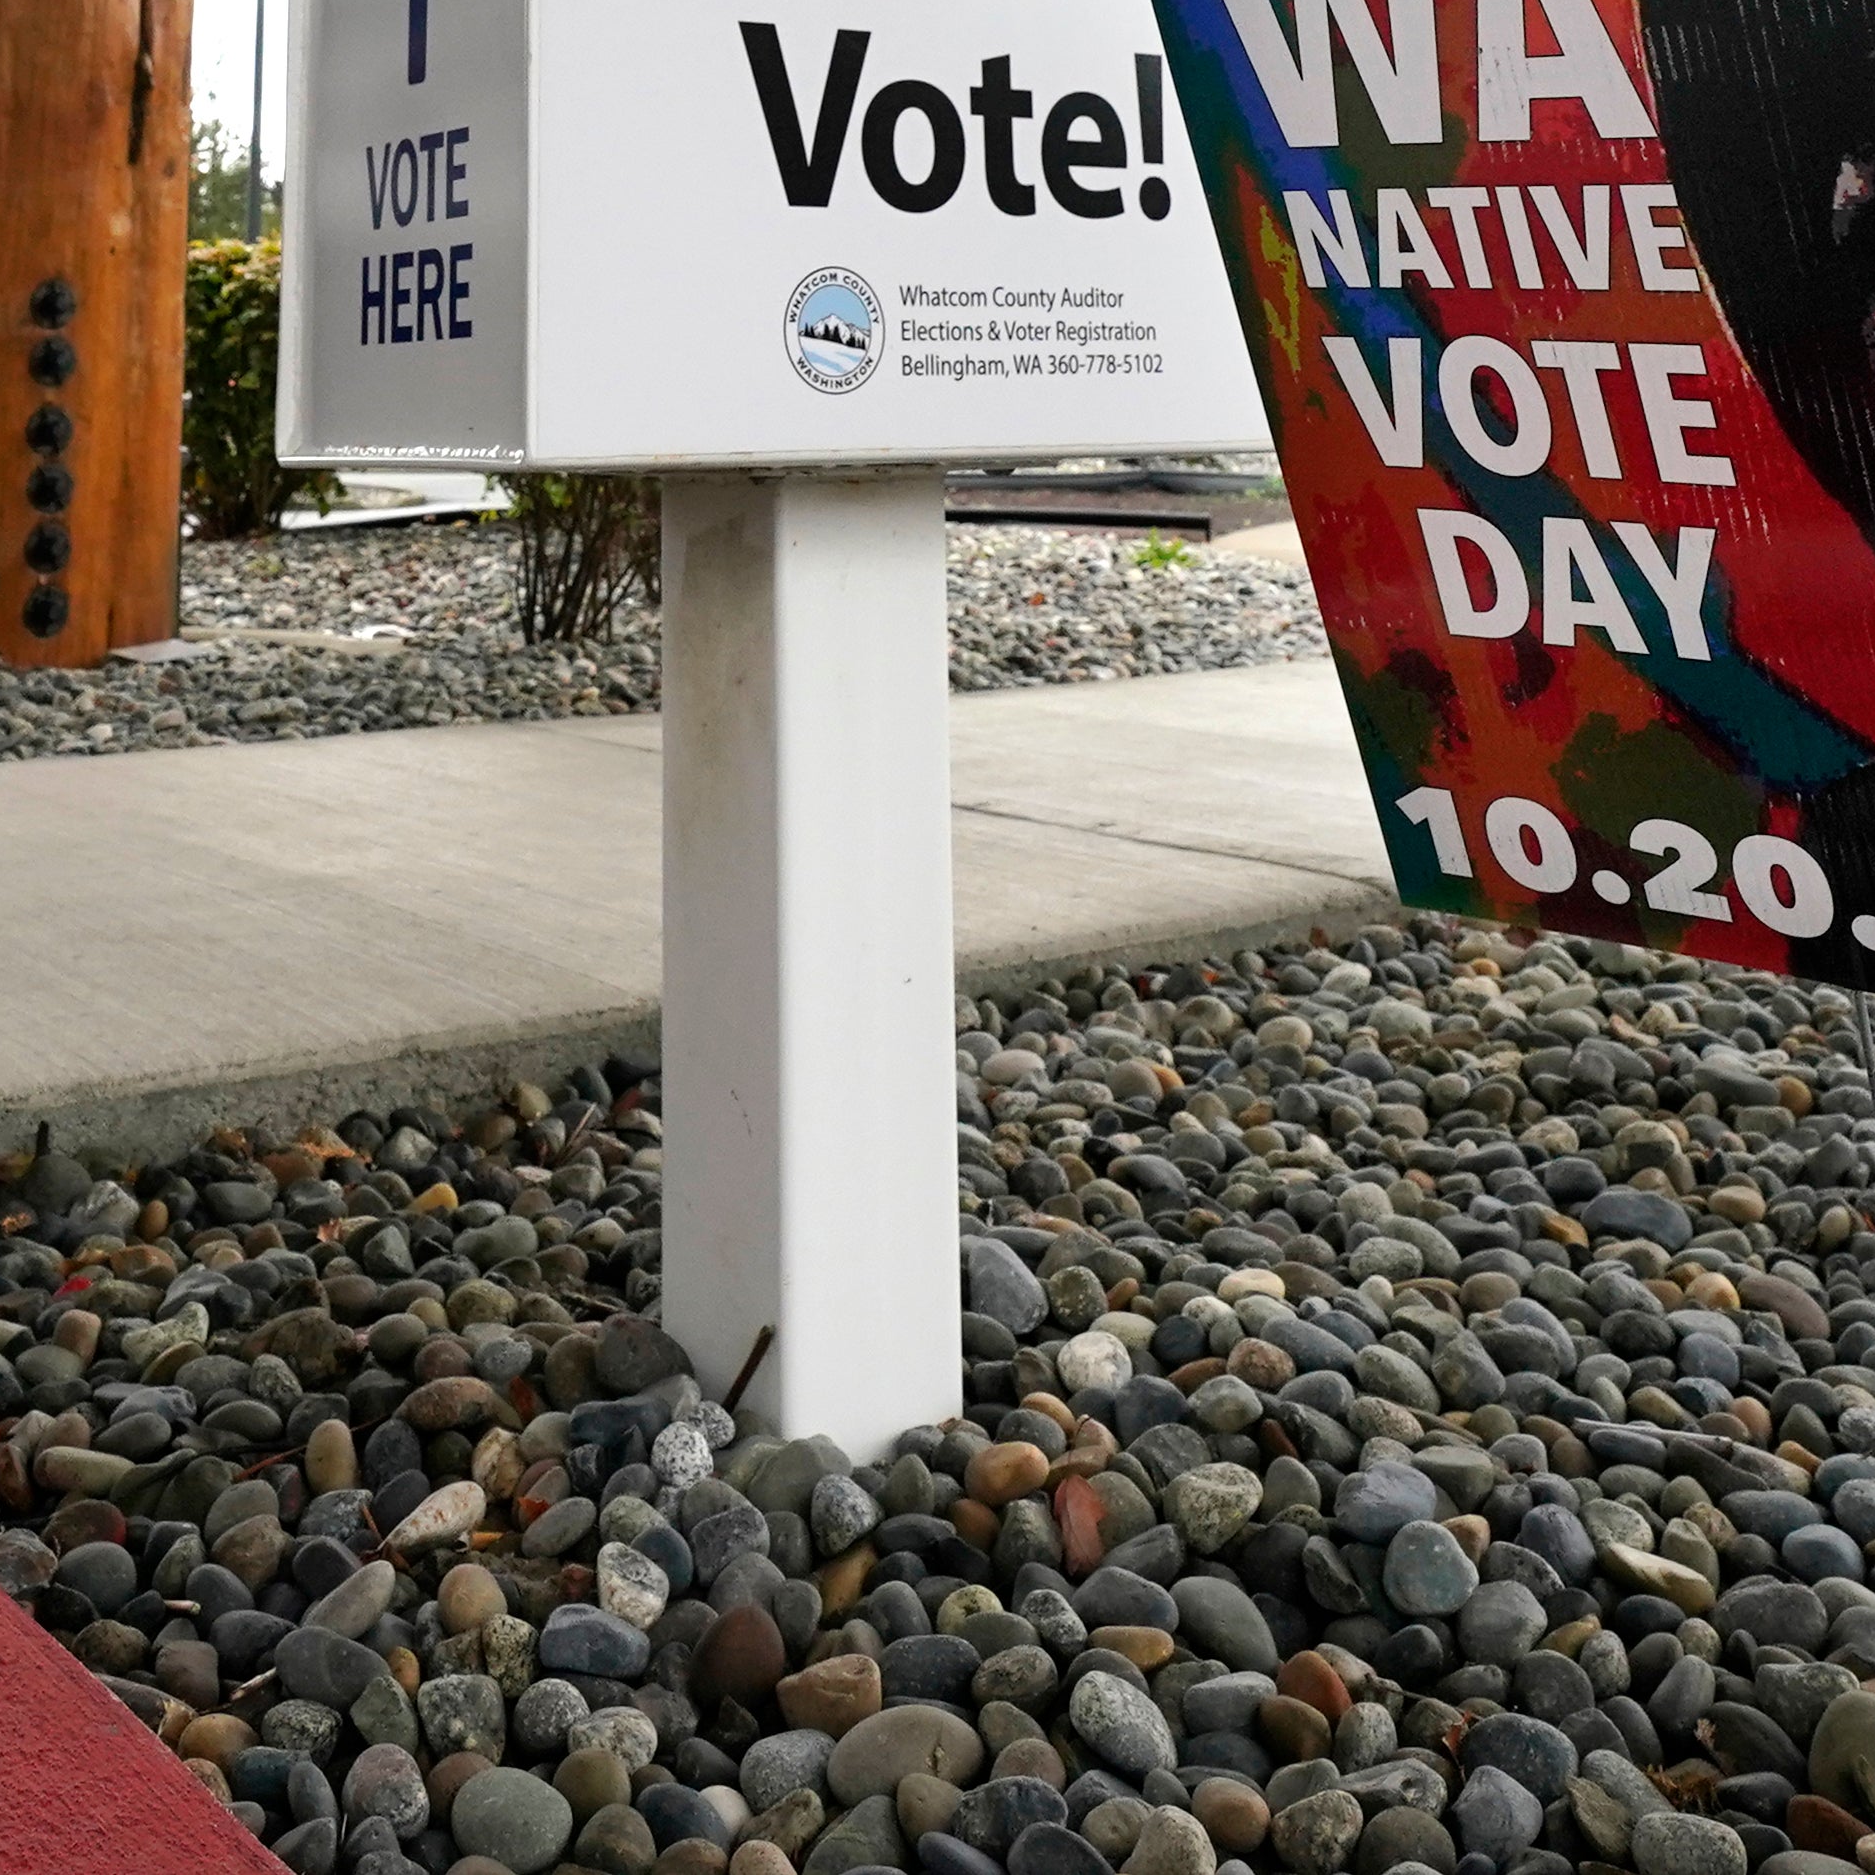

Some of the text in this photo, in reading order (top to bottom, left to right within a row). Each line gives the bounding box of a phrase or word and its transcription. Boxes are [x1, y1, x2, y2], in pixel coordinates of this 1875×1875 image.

[738, 20, 1171, 223] Vote!
[365, 126, 470, 230] VOTE
[1280, 182, 1701, 292] NATIVE
[361, 242, 473, 345] HERE
[789, 272, 880, 324] WHATCOM COUNTY
[899, 285, 1124, 313] Whatcom County Auditor
[900, 320, 1157, 347] Elections & Voter Registration
[797, 356, 874, 389] WASHINGTON
[901, 353, 1164, 382] Bellingham, WA 360-778-5102
[1323, 335, 1736, 488] VOTE
[1416, 508, 1718, 662] DAY
